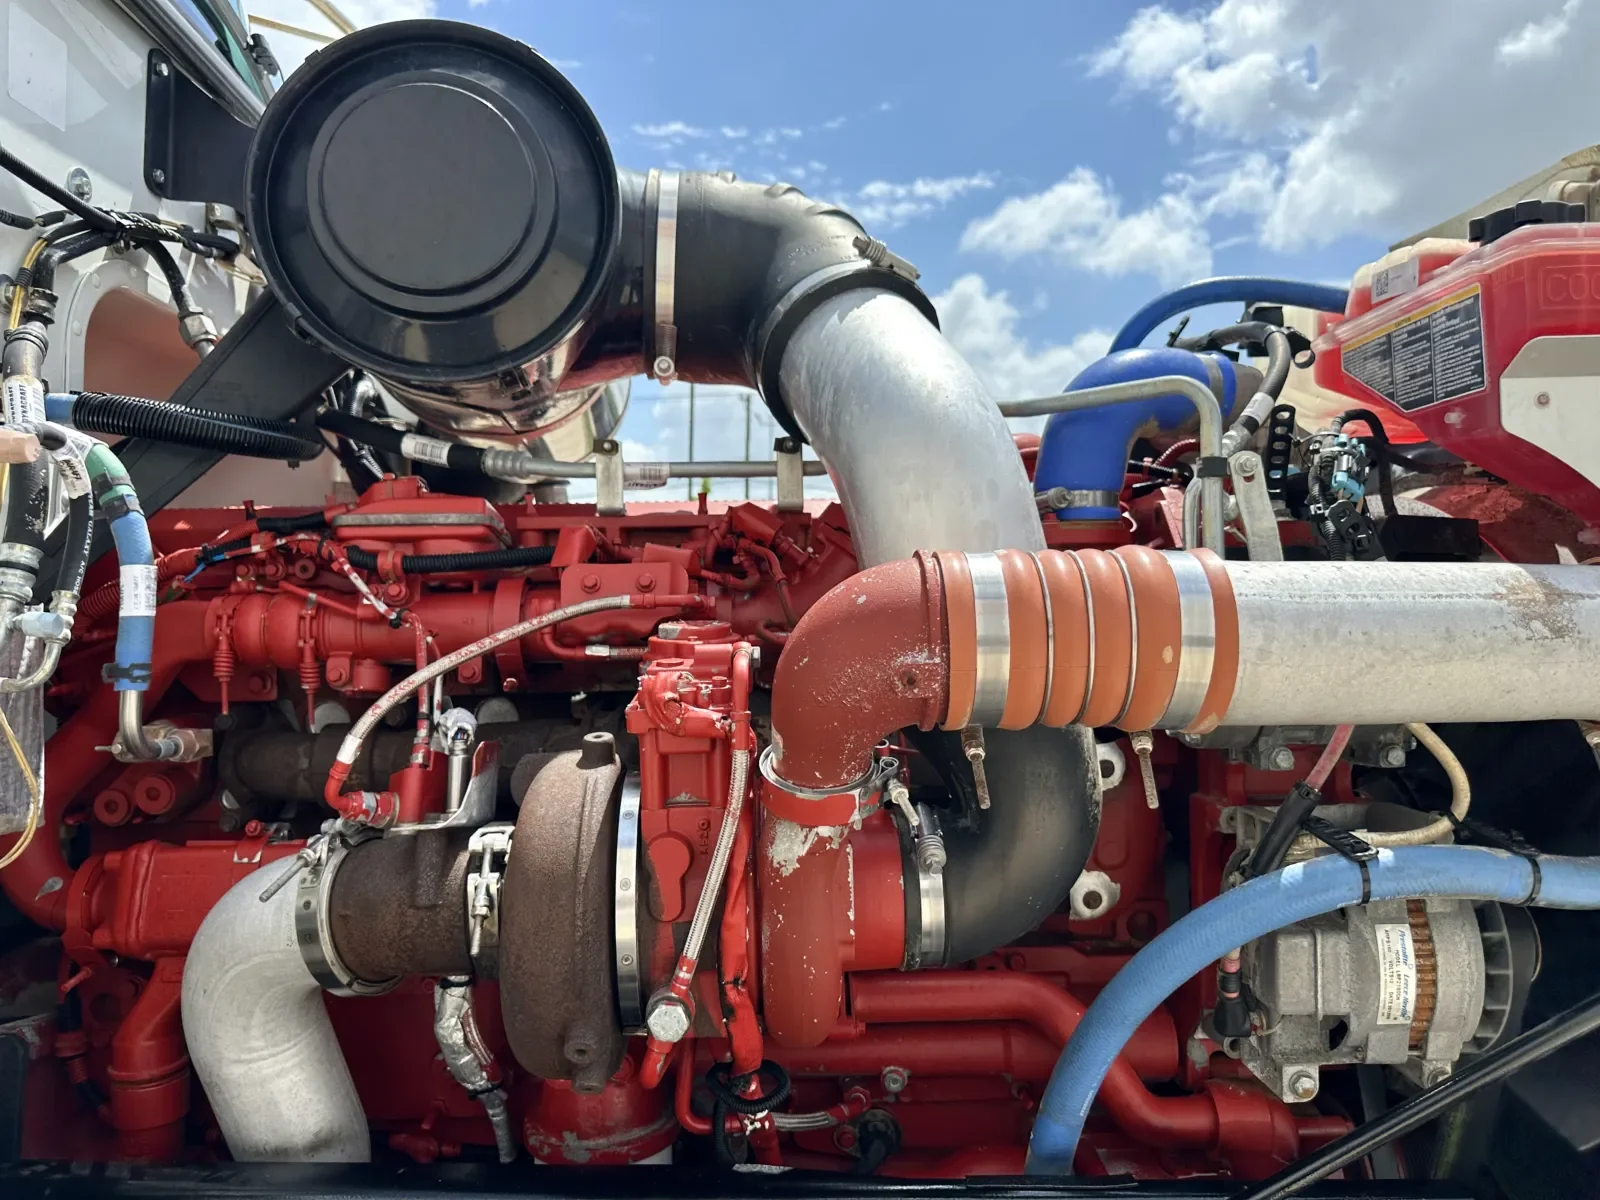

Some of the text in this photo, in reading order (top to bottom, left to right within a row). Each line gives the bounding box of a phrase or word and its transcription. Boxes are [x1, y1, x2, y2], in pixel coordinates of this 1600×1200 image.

[19, 384, 29, 424] DYNACRAFT
[82, 520, 93, 557] GALAXY
[78, 560, 86, 574] A/C
[1398, 929, 1409, 967] Prestolite
